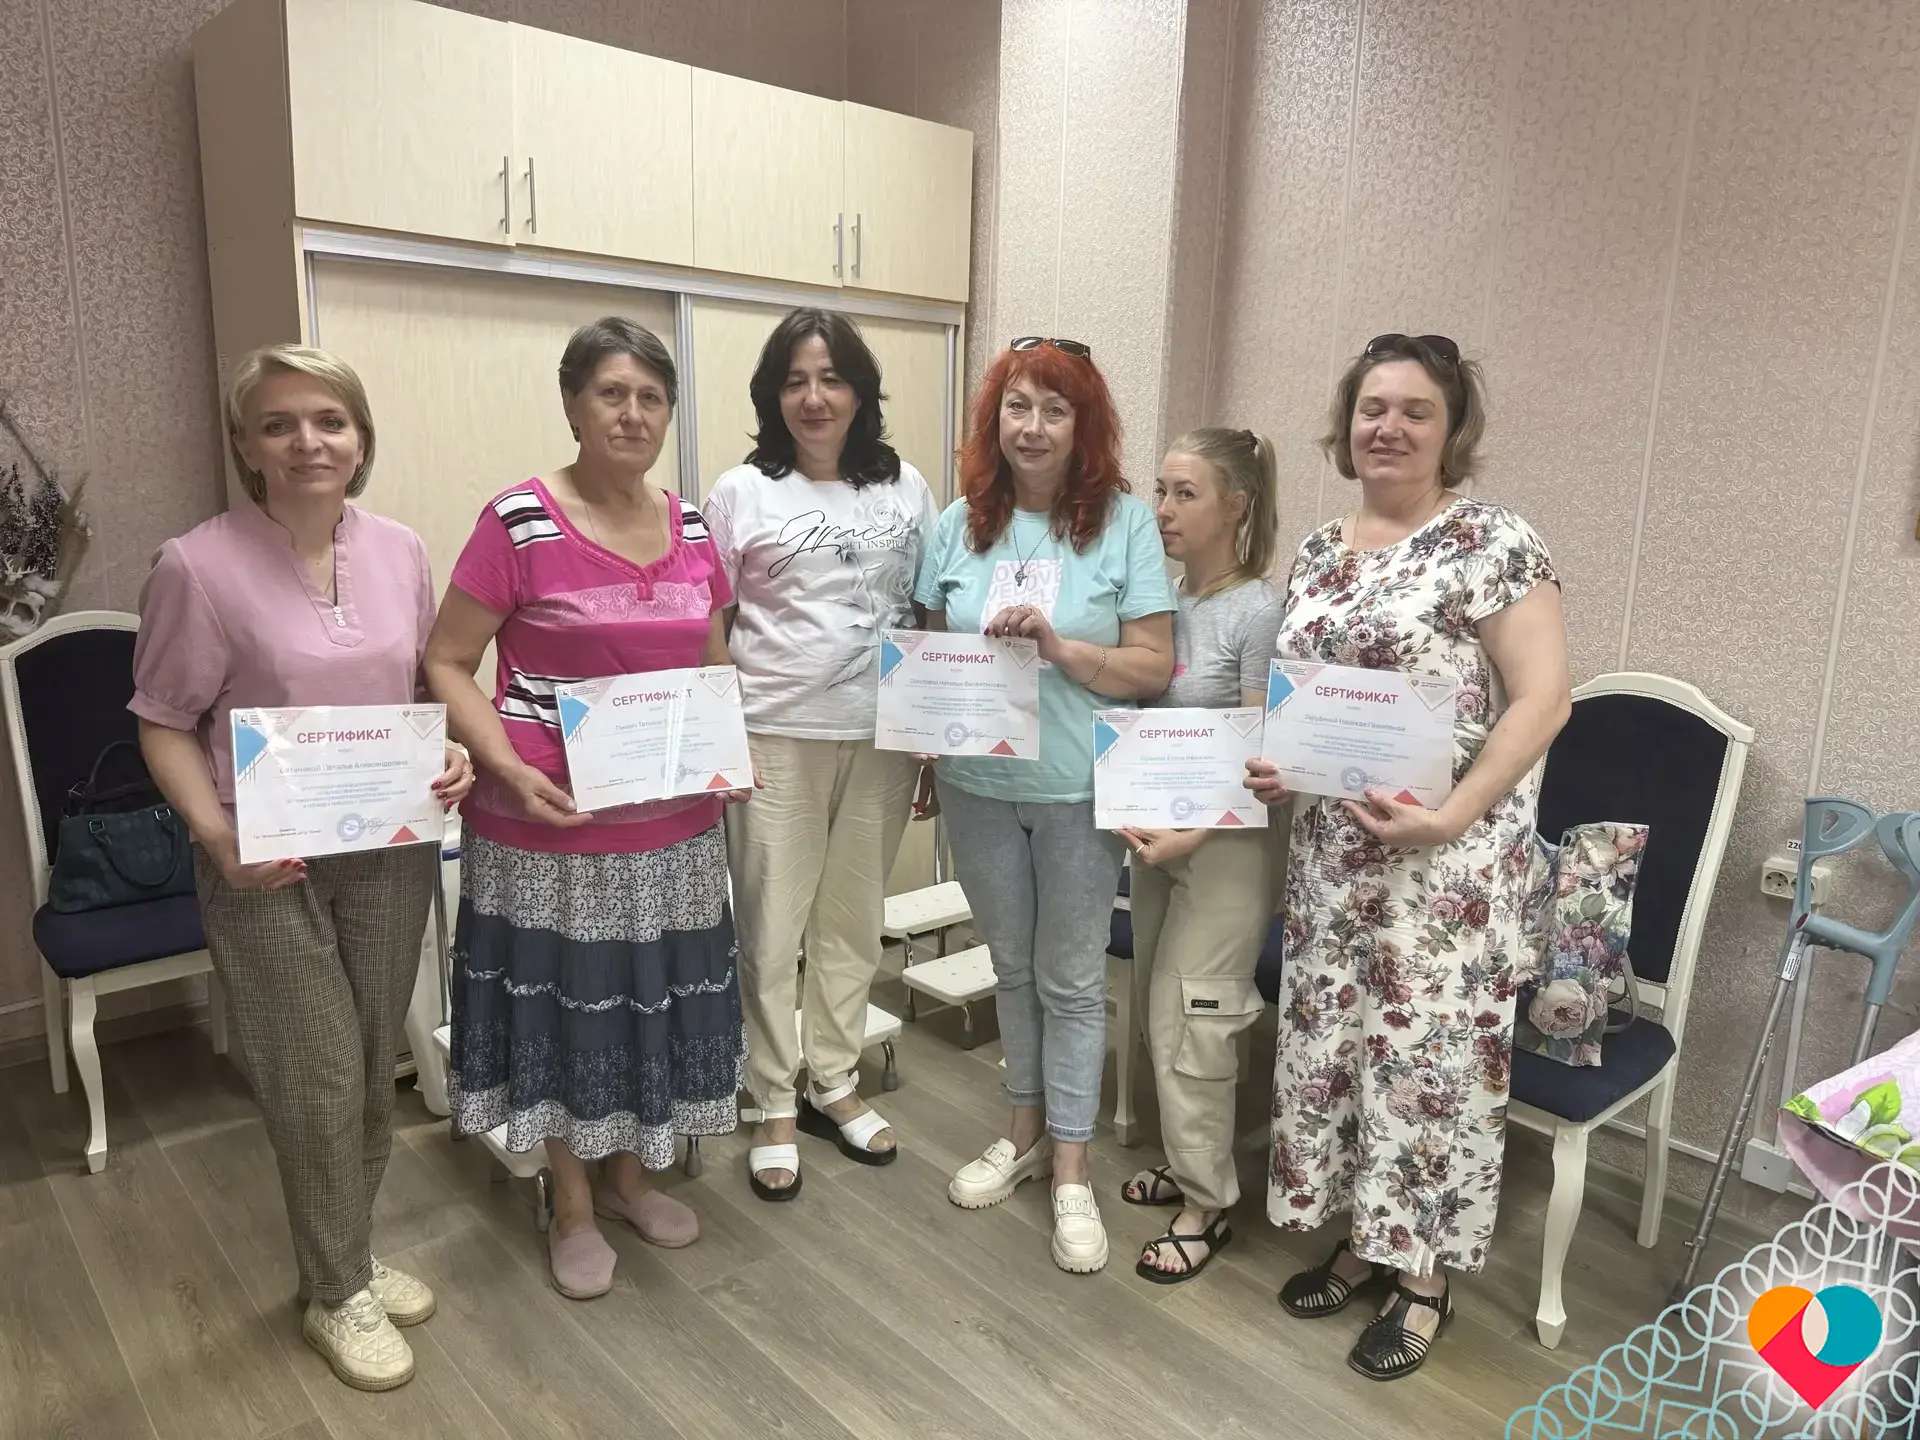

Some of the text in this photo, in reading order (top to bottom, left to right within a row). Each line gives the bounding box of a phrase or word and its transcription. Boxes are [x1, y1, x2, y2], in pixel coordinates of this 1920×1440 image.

[768, 509, 904, 579] Grace
[921, 651, 995, 664] СЕРТИФИКАТ
[612, 688, 693, 707] СЕРТИФИКТ
[1315, 685, 1399, 705] СЕРТИФИКАТ
[296, 728, 392, 744] СЕРТИФИКАТ
[1139, 728, 1216, 739] СЕРТИФИКАТ
